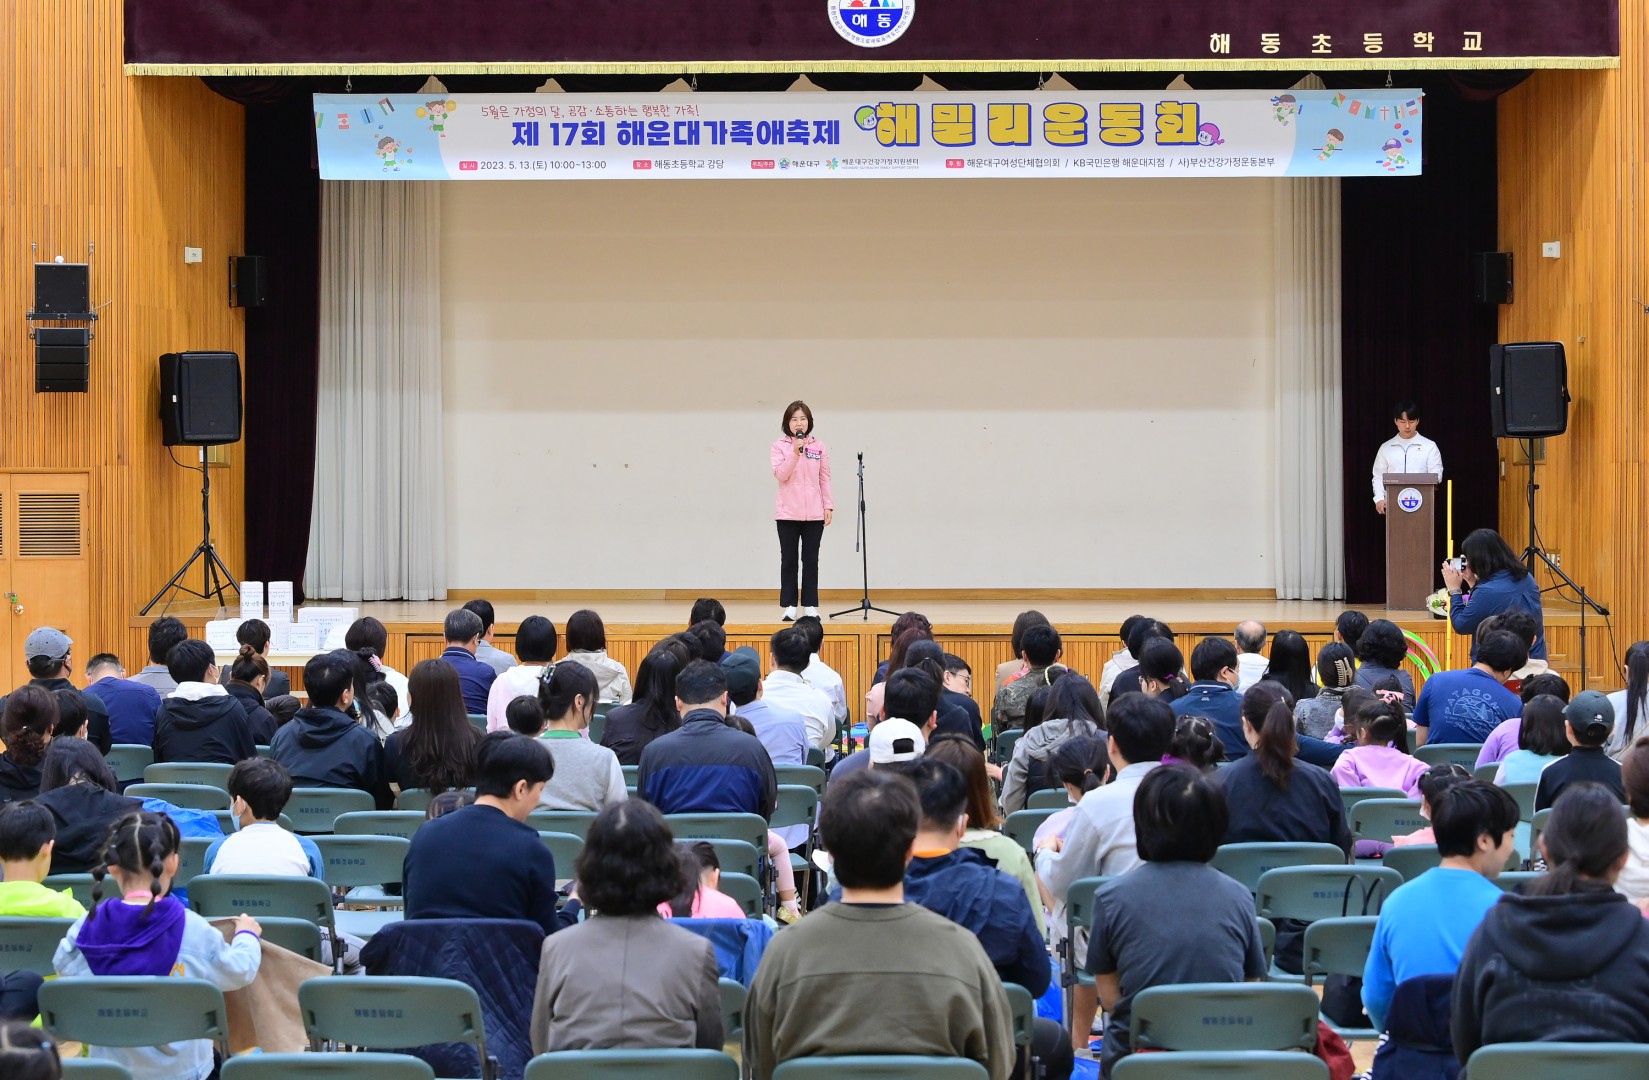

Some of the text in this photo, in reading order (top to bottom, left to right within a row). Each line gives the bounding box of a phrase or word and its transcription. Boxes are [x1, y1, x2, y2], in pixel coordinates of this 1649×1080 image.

[1209, 31, 1483, 54] 해동초등학교
[481, 105, 510, 119] 5월은
[513, 106, 547, 118] 가정의
[550, 106, 565, 119] 달,
[641, 105, 671, 118] 행복한
[674, 104, 700, 117] 가족!
[875, 102, 1201, 147] 해밀리운동회
[511, 118, 841, 147] 제 17회 해운대가족애축제
[480, 161, 507, 170] 2023.
[508, 161, 517, 170] 5.
[519, 160, 548, 171] 13.(토)
[549, 160, 607, 170] 10:00~13:00
[654, 159, 705, 170] 해동초등학교
[707, 159, 725, 169] 강당
[791, 160, 821, 169] 해운대구
[966, 158, 1060, 169] 해운대구여성단체협의회
[1073, 157, 1120, 168] KB국민은행
[1122, 157, 1165, 168] 해운대지점
[1177, 157, 1275, 169] 사)부산건강가정운동본부
[1444, 687, 1503, 725] PATAGONA
